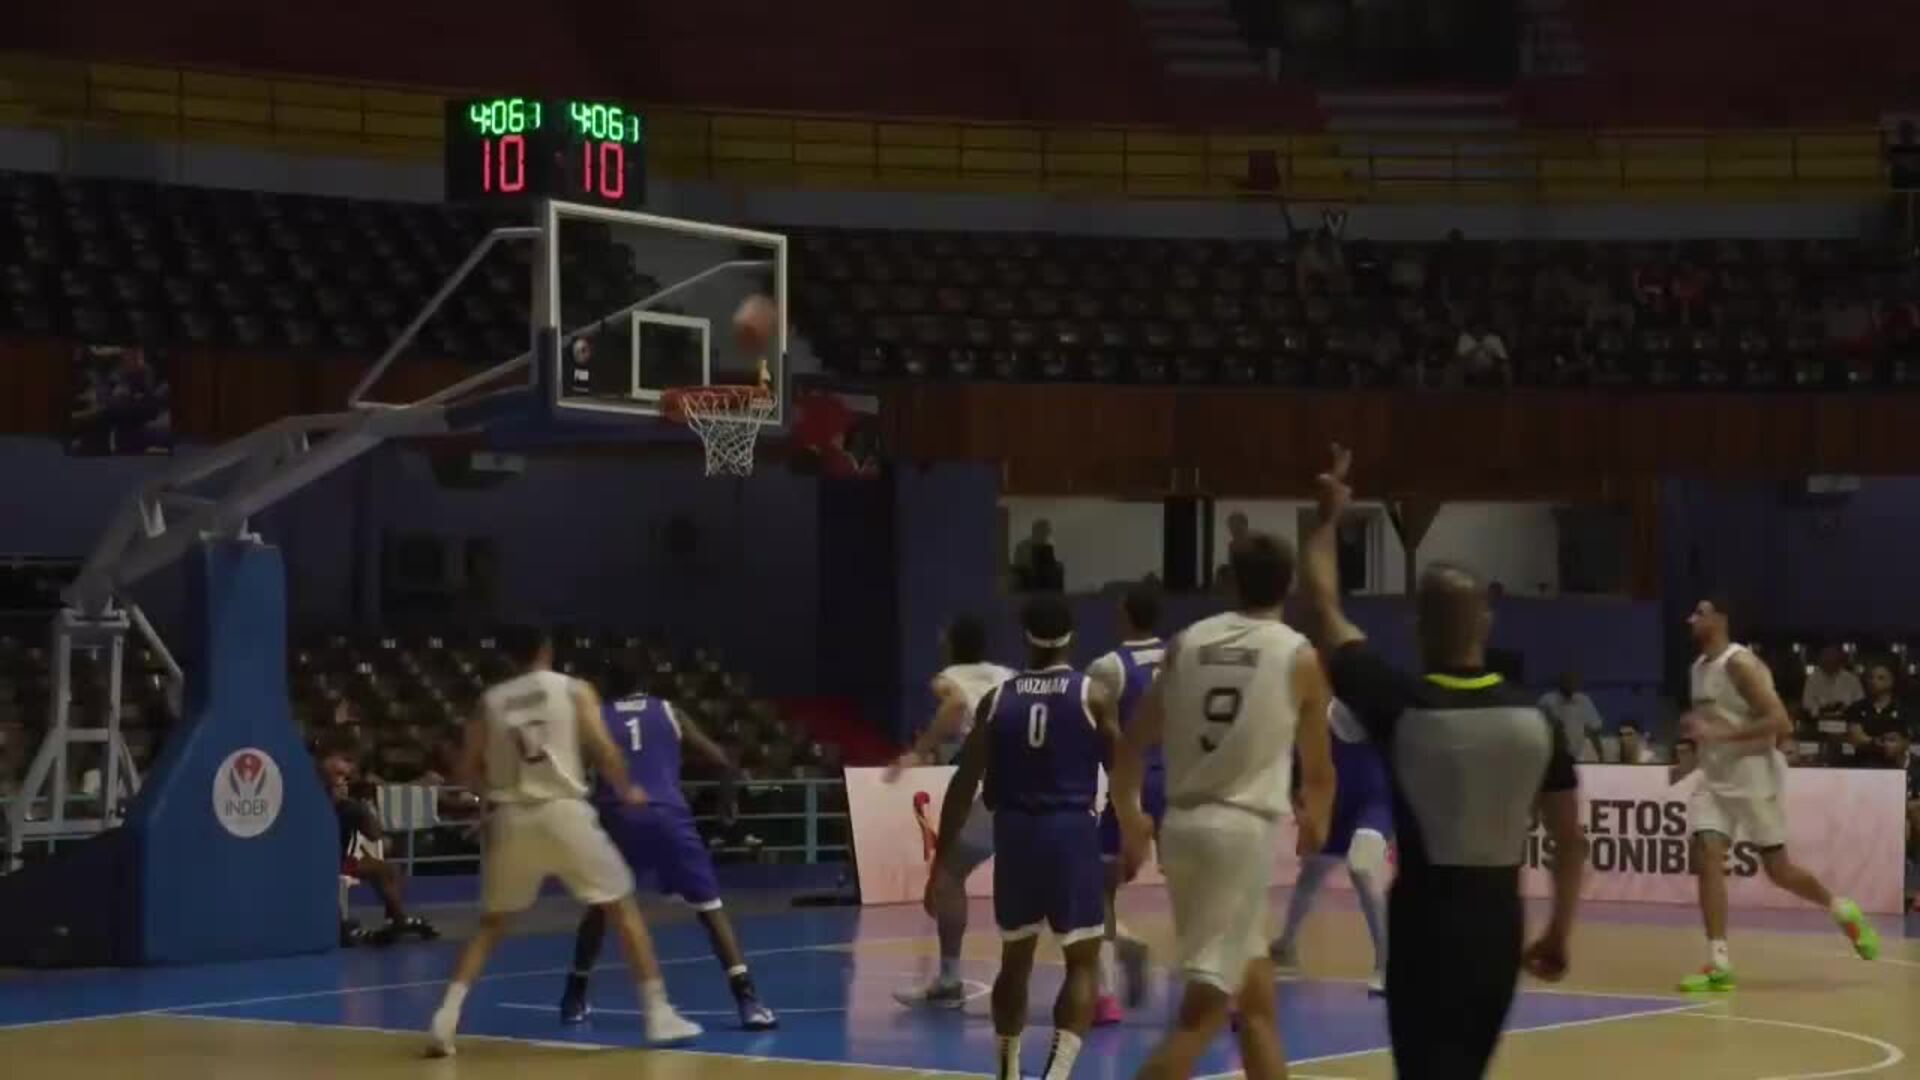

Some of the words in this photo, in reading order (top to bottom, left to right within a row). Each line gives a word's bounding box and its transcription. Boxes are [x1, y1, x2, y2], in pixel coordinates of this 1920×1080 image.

[483, 135, 525, 192] 10
[584, 140, 625, 199] 10
[623, 716, 643, 751] 1
[1028, 702, 1048, 749] 0
[1199, 686, 1242, 753] 9
[225, 799, 269, 816] INDER
[1583, 799, 1687, 837] ETOS
